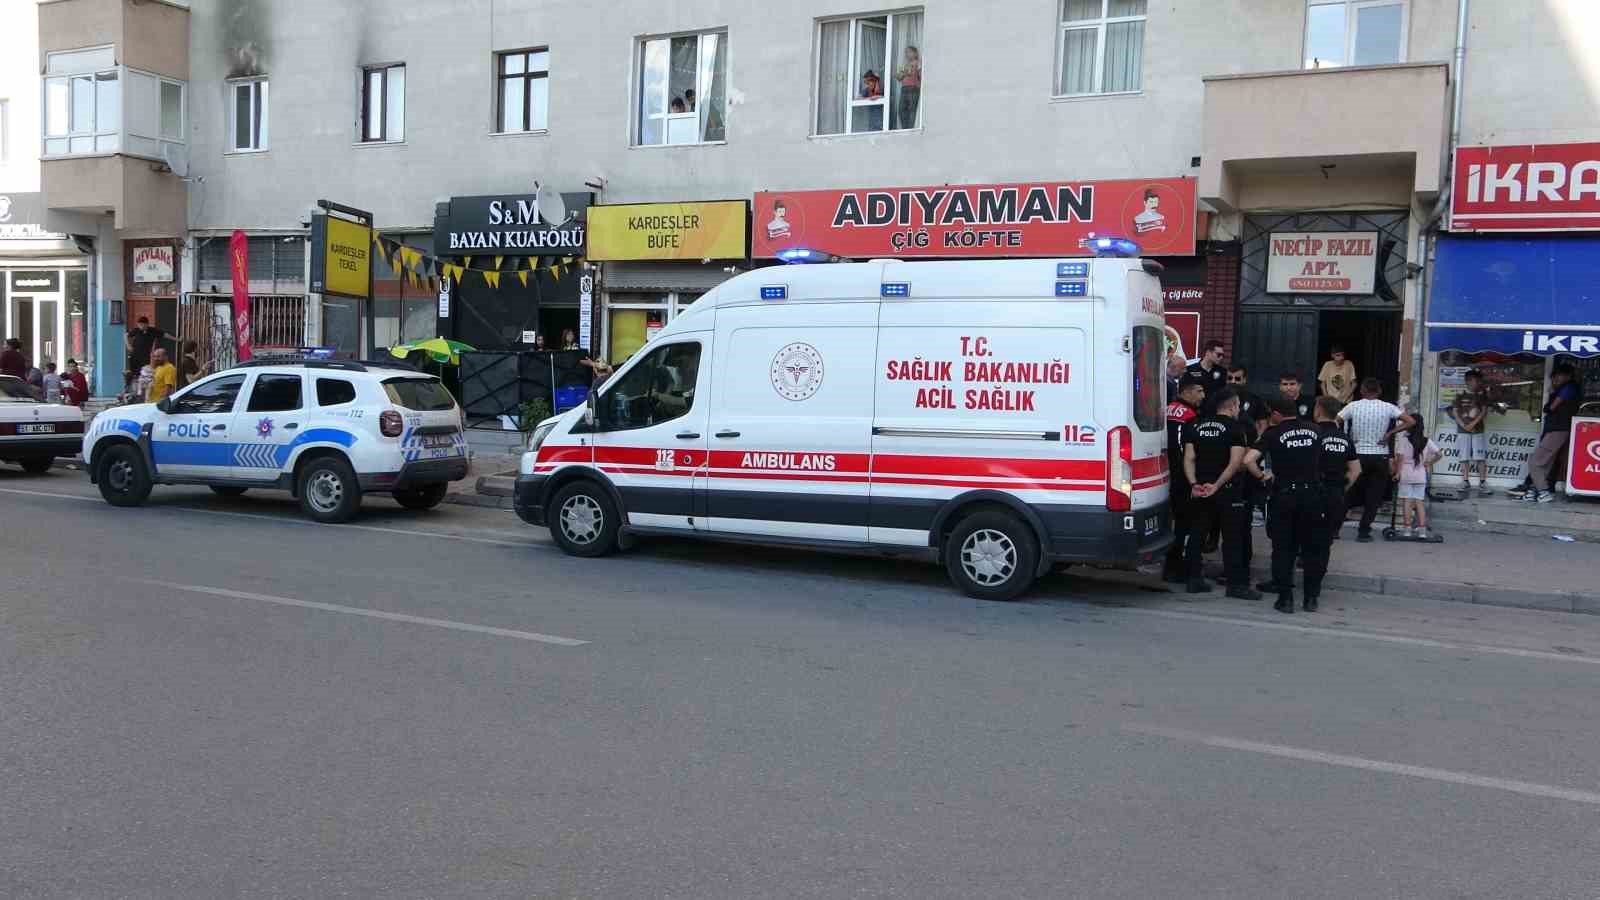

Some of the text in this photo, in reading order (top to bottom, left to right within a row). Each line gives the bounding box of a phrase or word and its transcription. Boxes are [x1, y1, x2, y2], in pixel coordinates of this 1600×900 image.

[489, 200, 541, 225] S & M
[832, 185, 1094, 228] ADIYAMAN
[628, 215, 700, 233] KARDEŞLER
[450, 226, 584, 248] BAYAN KUAFÖRÜ
[647, 232, 680, 248] BÜFE
[891, 228, 1022, 252] ÇİĞ KÖFTE
[1272, 235, 1374, 257] NECİP FAZIL
[1302, 261, 1341, 275] APT.
[960, 336, 993, 356] T.C.
[887, 356, 1070, 384] SAĞLIK BAKANLIĞI
[915, 385, 1034, 411] ACİL SAĞLIK
[168, 419, 210, 438] POLİS
[1064, 424, 1096, 442] 112
[1489, 433, 1536, 447] ÖDEME
[656, 449, 675, 462] 112
[741, 453, 836, 470] AMBULANS
[1484, 448, 1529, 462] YÜKLEM
